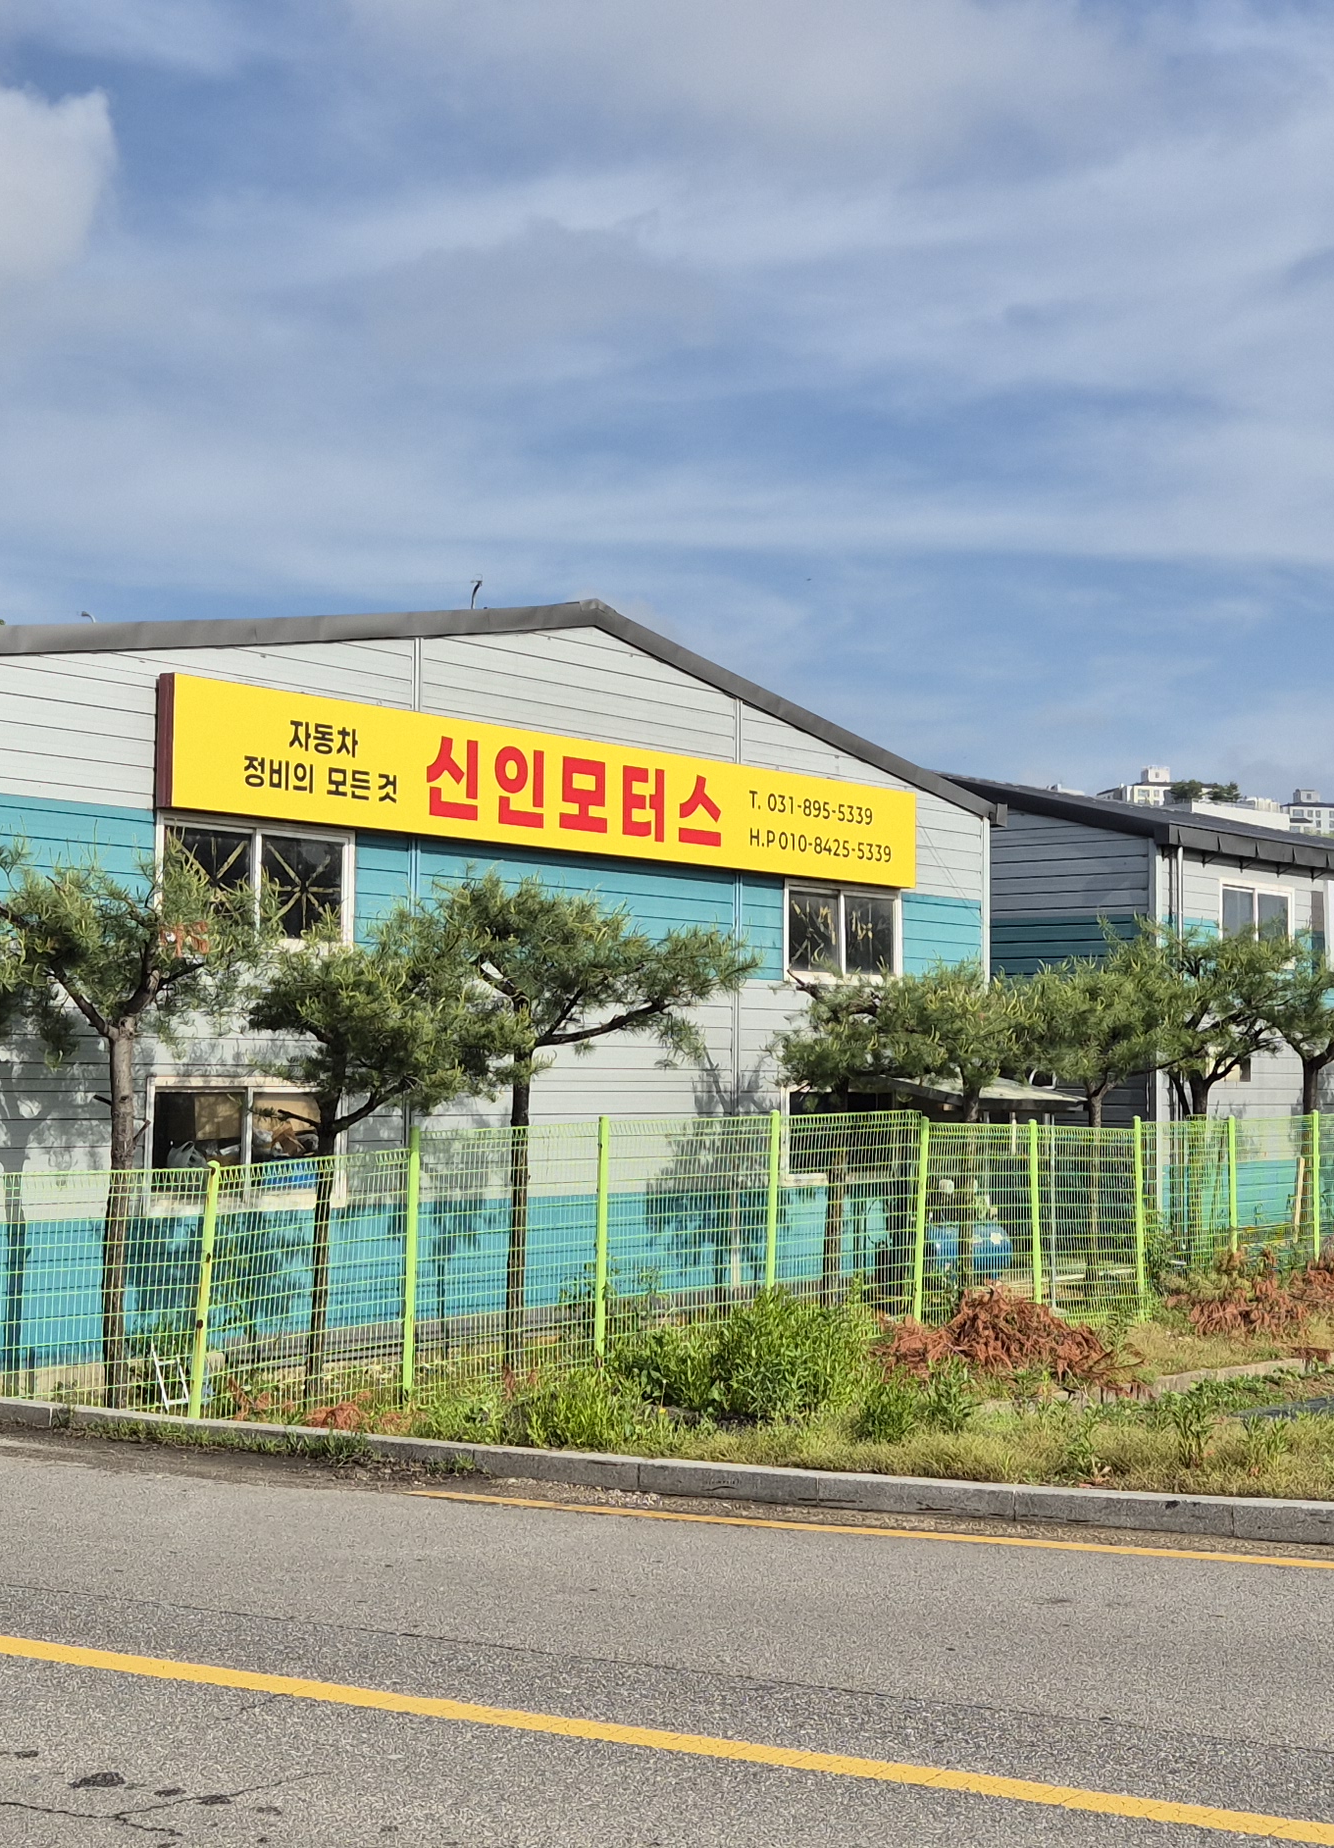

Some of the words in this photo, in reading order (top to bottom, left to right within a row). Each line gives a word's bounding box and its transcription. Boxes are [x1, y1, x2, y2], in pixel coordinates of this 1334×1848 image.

[288, 719, 359, 759] 자동차
[243, 755, 314, 795] 정비의
[426, 735, 722, 848] 신인모터스
[767, 792, 873, 826] 031-895-5339
